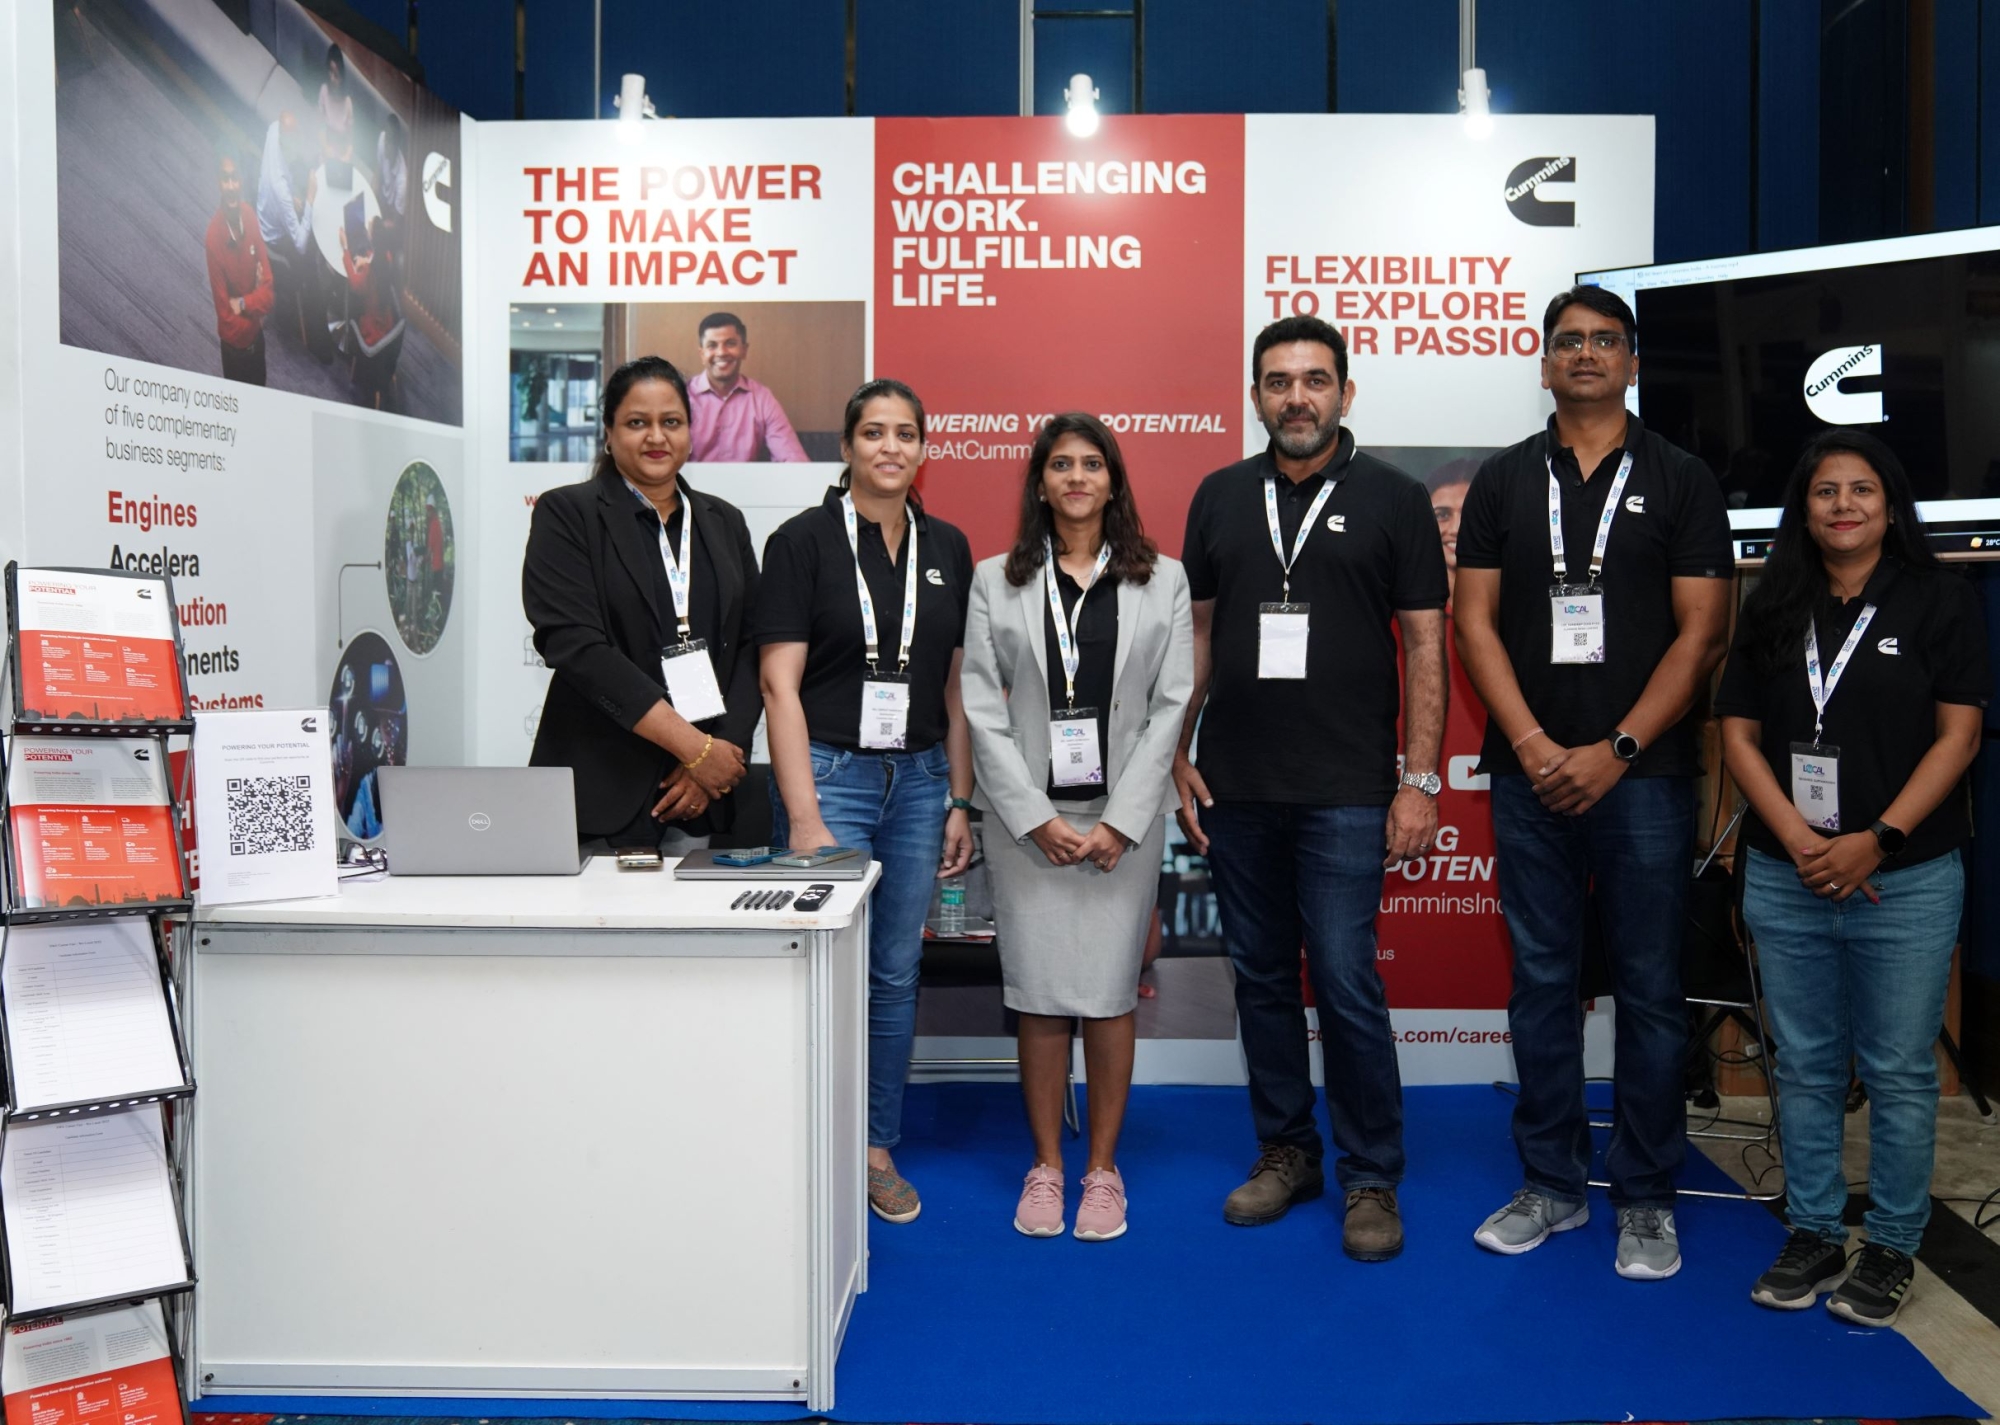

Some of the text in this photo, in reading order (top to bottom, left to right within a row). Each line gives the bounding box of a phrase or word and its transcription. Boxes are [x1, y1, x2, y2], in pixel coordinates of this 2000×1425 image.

[523, 164, 822, 202] THE POWER
[892, 161, 1206, 195] CHALLENGING
[1504, 156, 1570, 202] Cummins
[523, 208, 751, 244] TO MAKE
[891, 199, 1038, 232] WORK.
[522, 250, 797, 286] AN IMPACT
[893, 235, 1141, 269] FULFILLING
[1265, 256, 1512, 285] FLEXIBILITY
[893, 273, 997, 307] LIFE.
[1264, 290, 1526, 320] TO EXPLORE
[1394, 326, 1540, 357] PASSIO
[1805, 345, 1874, 398] Cummins
[104, 368, 239, 413] Our company consists
[105, 404, 237, 447] of five complementary
[925, 413, 1019, 433] WERING
[1099, 413, 1227, 433] POTENTIAL
[106, 436, 226, 472] business segments:
[108, 491, 197, 532] Engines
[110, 544, 200, 577] Accelera
[24, 747, 68, 755] POWERING
[12, 1317, 63, 1334] POTENTIAL
